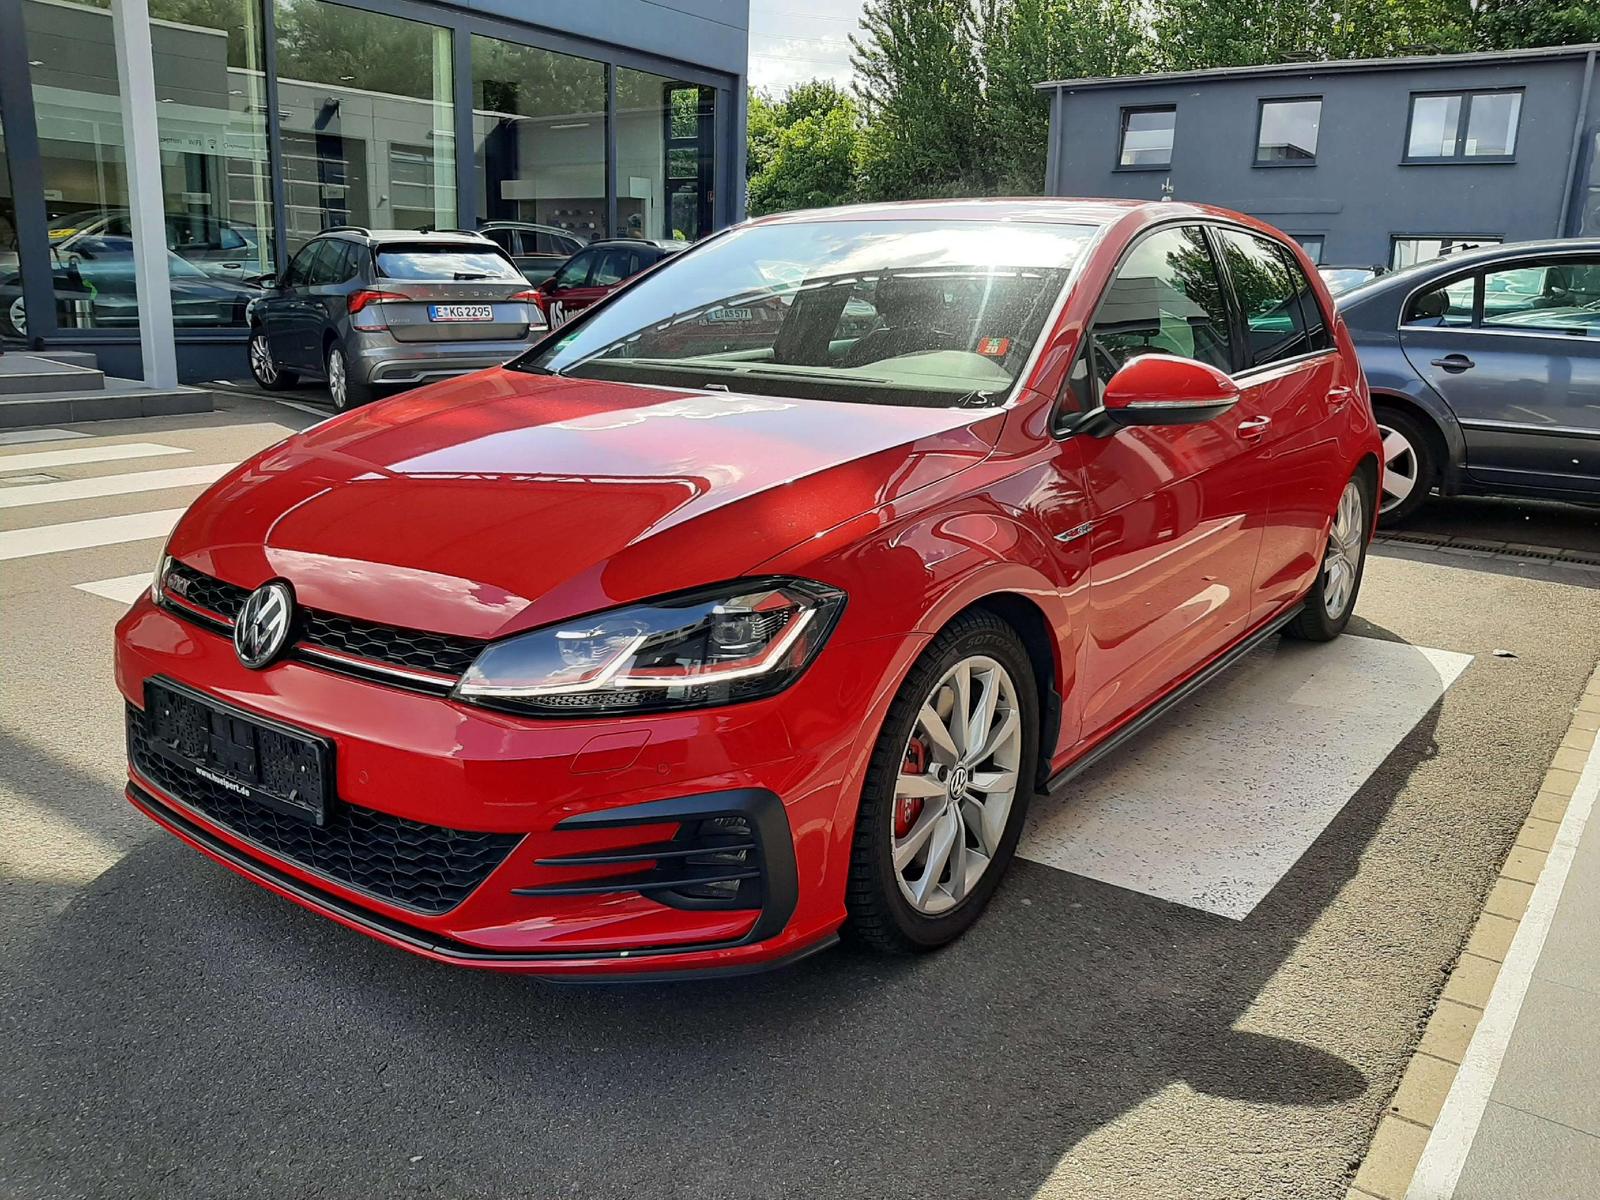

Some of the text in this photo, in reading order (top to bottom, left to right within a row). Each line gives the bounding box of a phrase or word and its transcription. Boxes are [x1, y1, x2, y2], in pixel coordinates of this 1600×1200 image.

[436, 306, 491, 318] E KG 2295
[550, 300, 565, 330] AS
